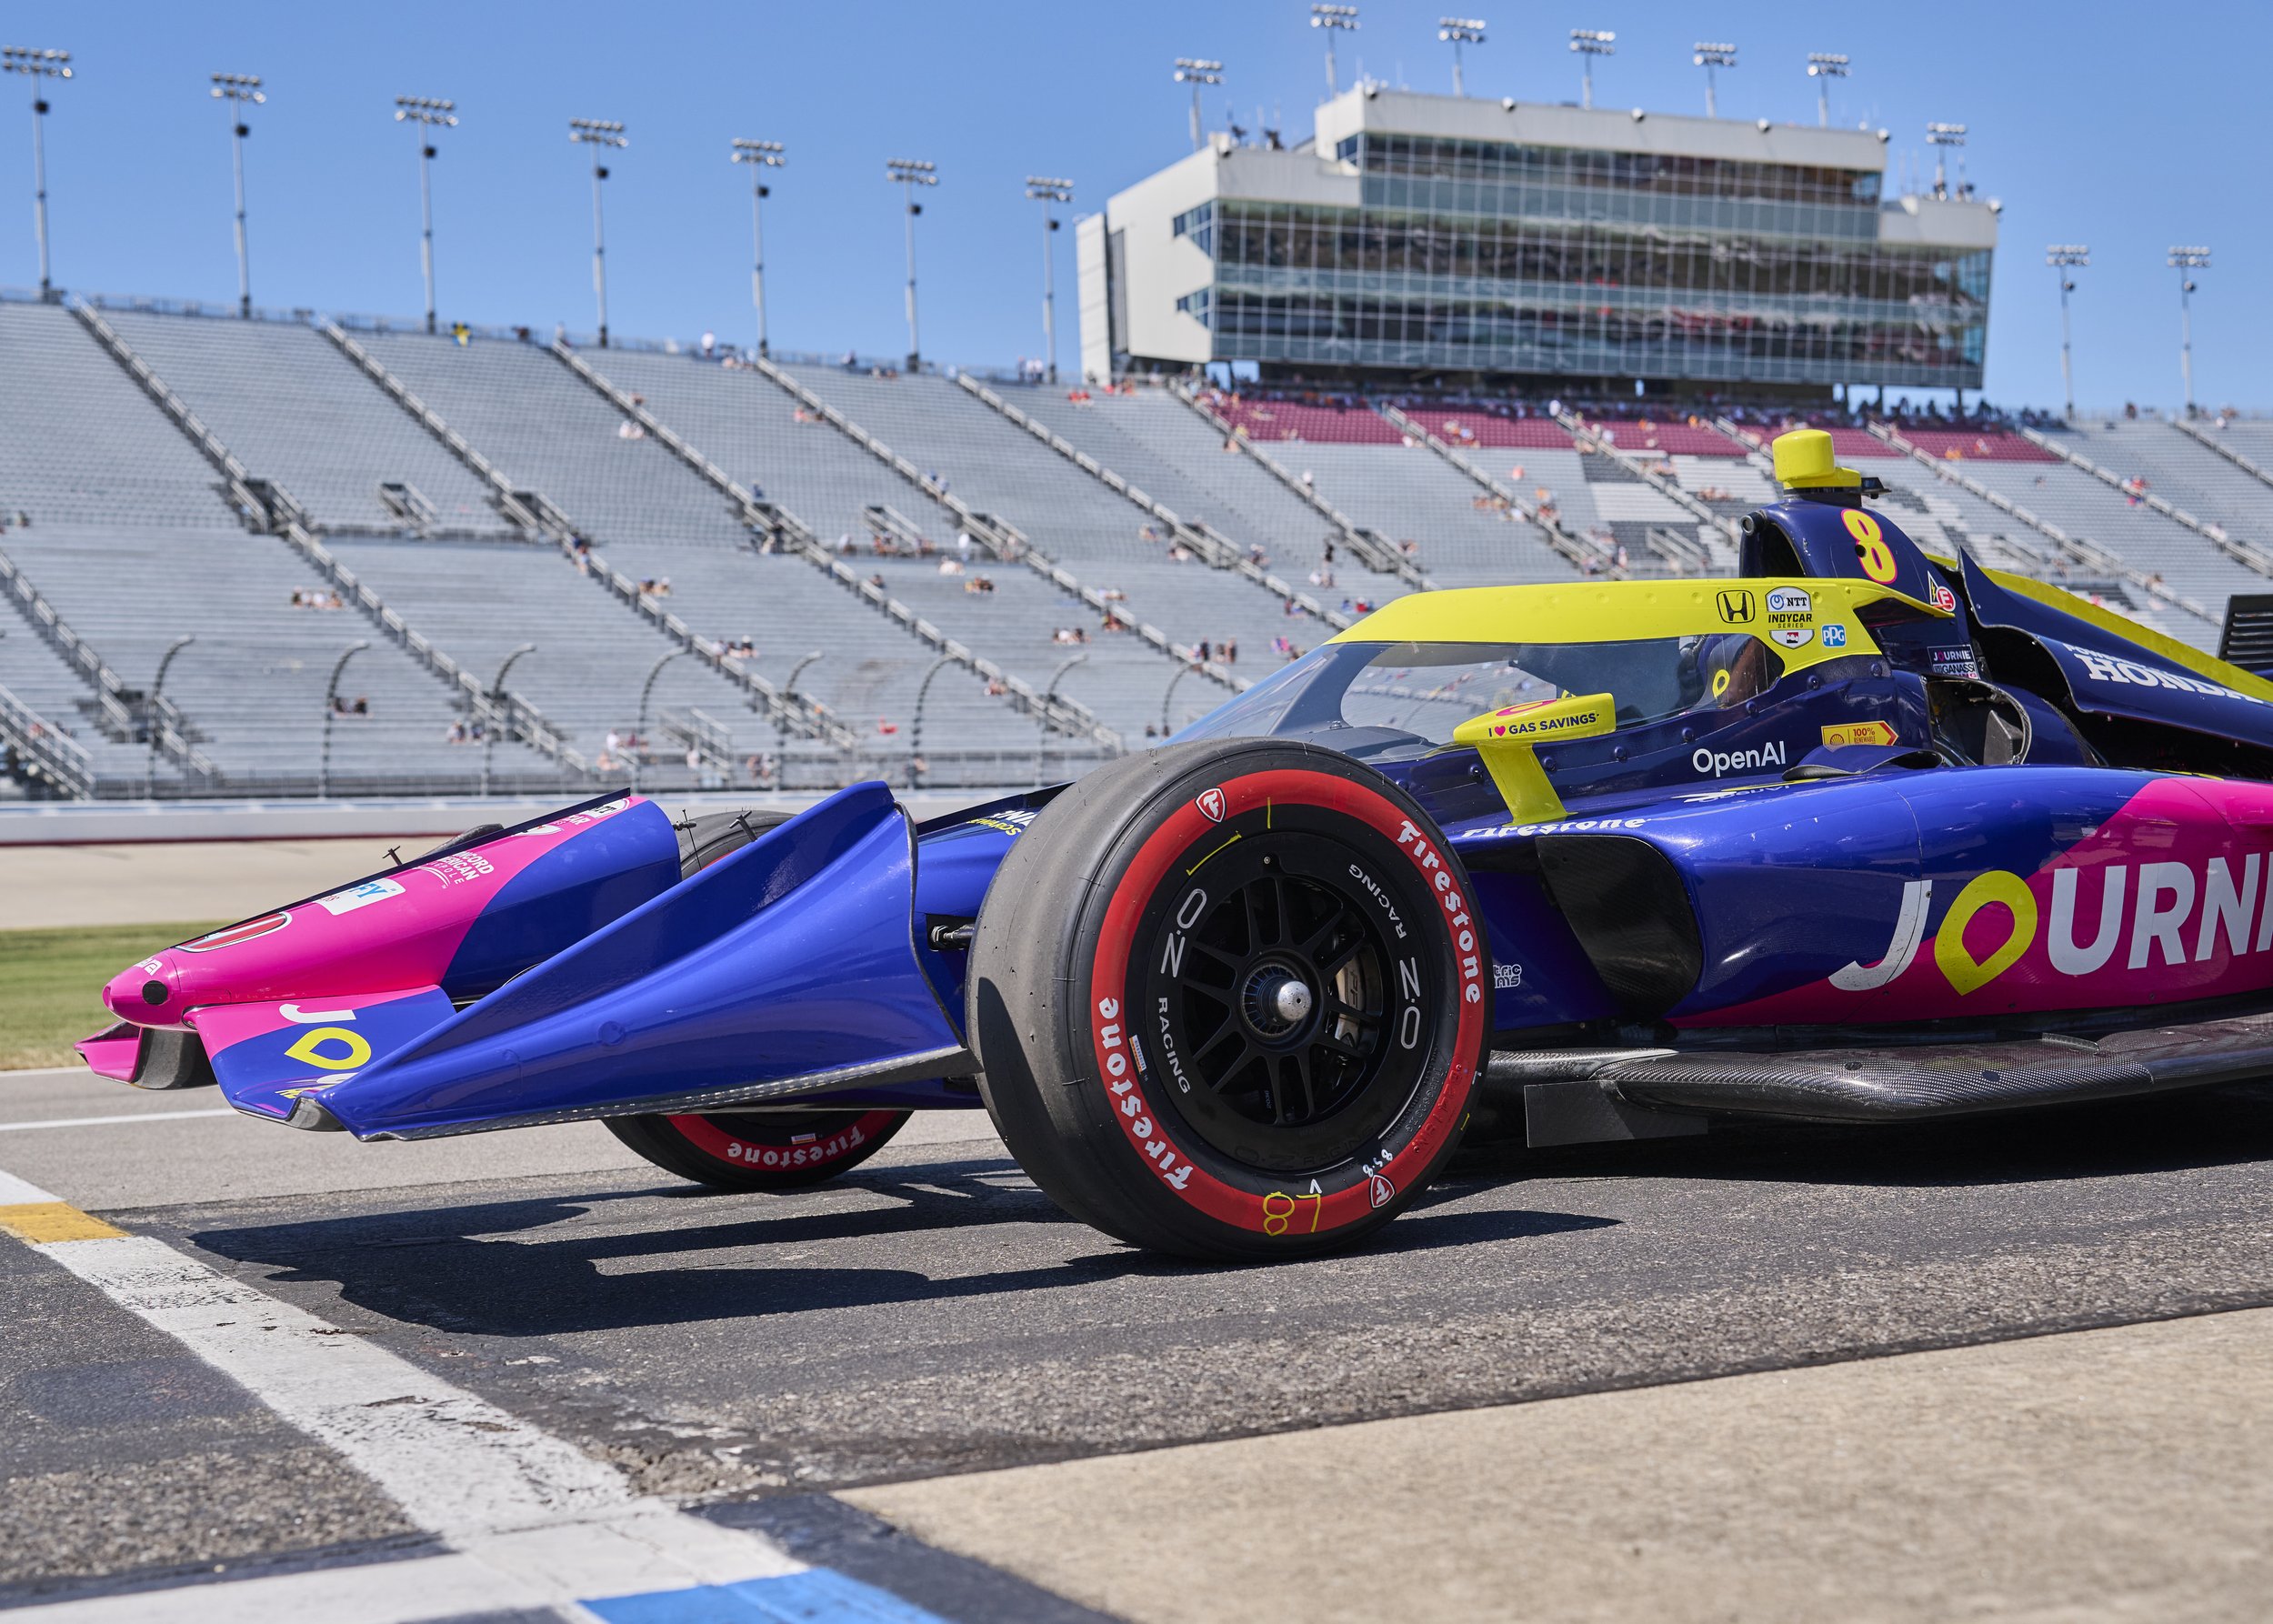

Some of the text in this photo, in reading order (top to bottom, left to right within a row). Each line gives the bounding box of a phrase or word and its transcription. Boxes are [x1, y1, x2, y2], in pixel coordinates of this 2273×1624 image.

[1840, 507, 1898, 585] 8
[1786, 596, 1807, 606] NTT
[1767, 613, 1813, 623] INDYCAR
[1823, 627, 1845, 646] PPG
[1933, 650, 1971, 662] JOURNIE
[1942, 663, 1975, 674] GANASSI
[1488, 727, 1493, 737] I
[1508, 722, 1537, 735] GAS
[1852, 727, 1876, 737] 100%
[1692, 740, 1787, 777] OpenAI
[1460, 817, 1652, 838] Firestone
[1348, 863, 1407, 939] RACING
[1397, 819, 1482, 1004] Firestone
[1157, 997, 1191, 1094] RACING
[1098, 997, 1195, 1190] Firestone
[727, 1125, 865, 1168] Firestone
